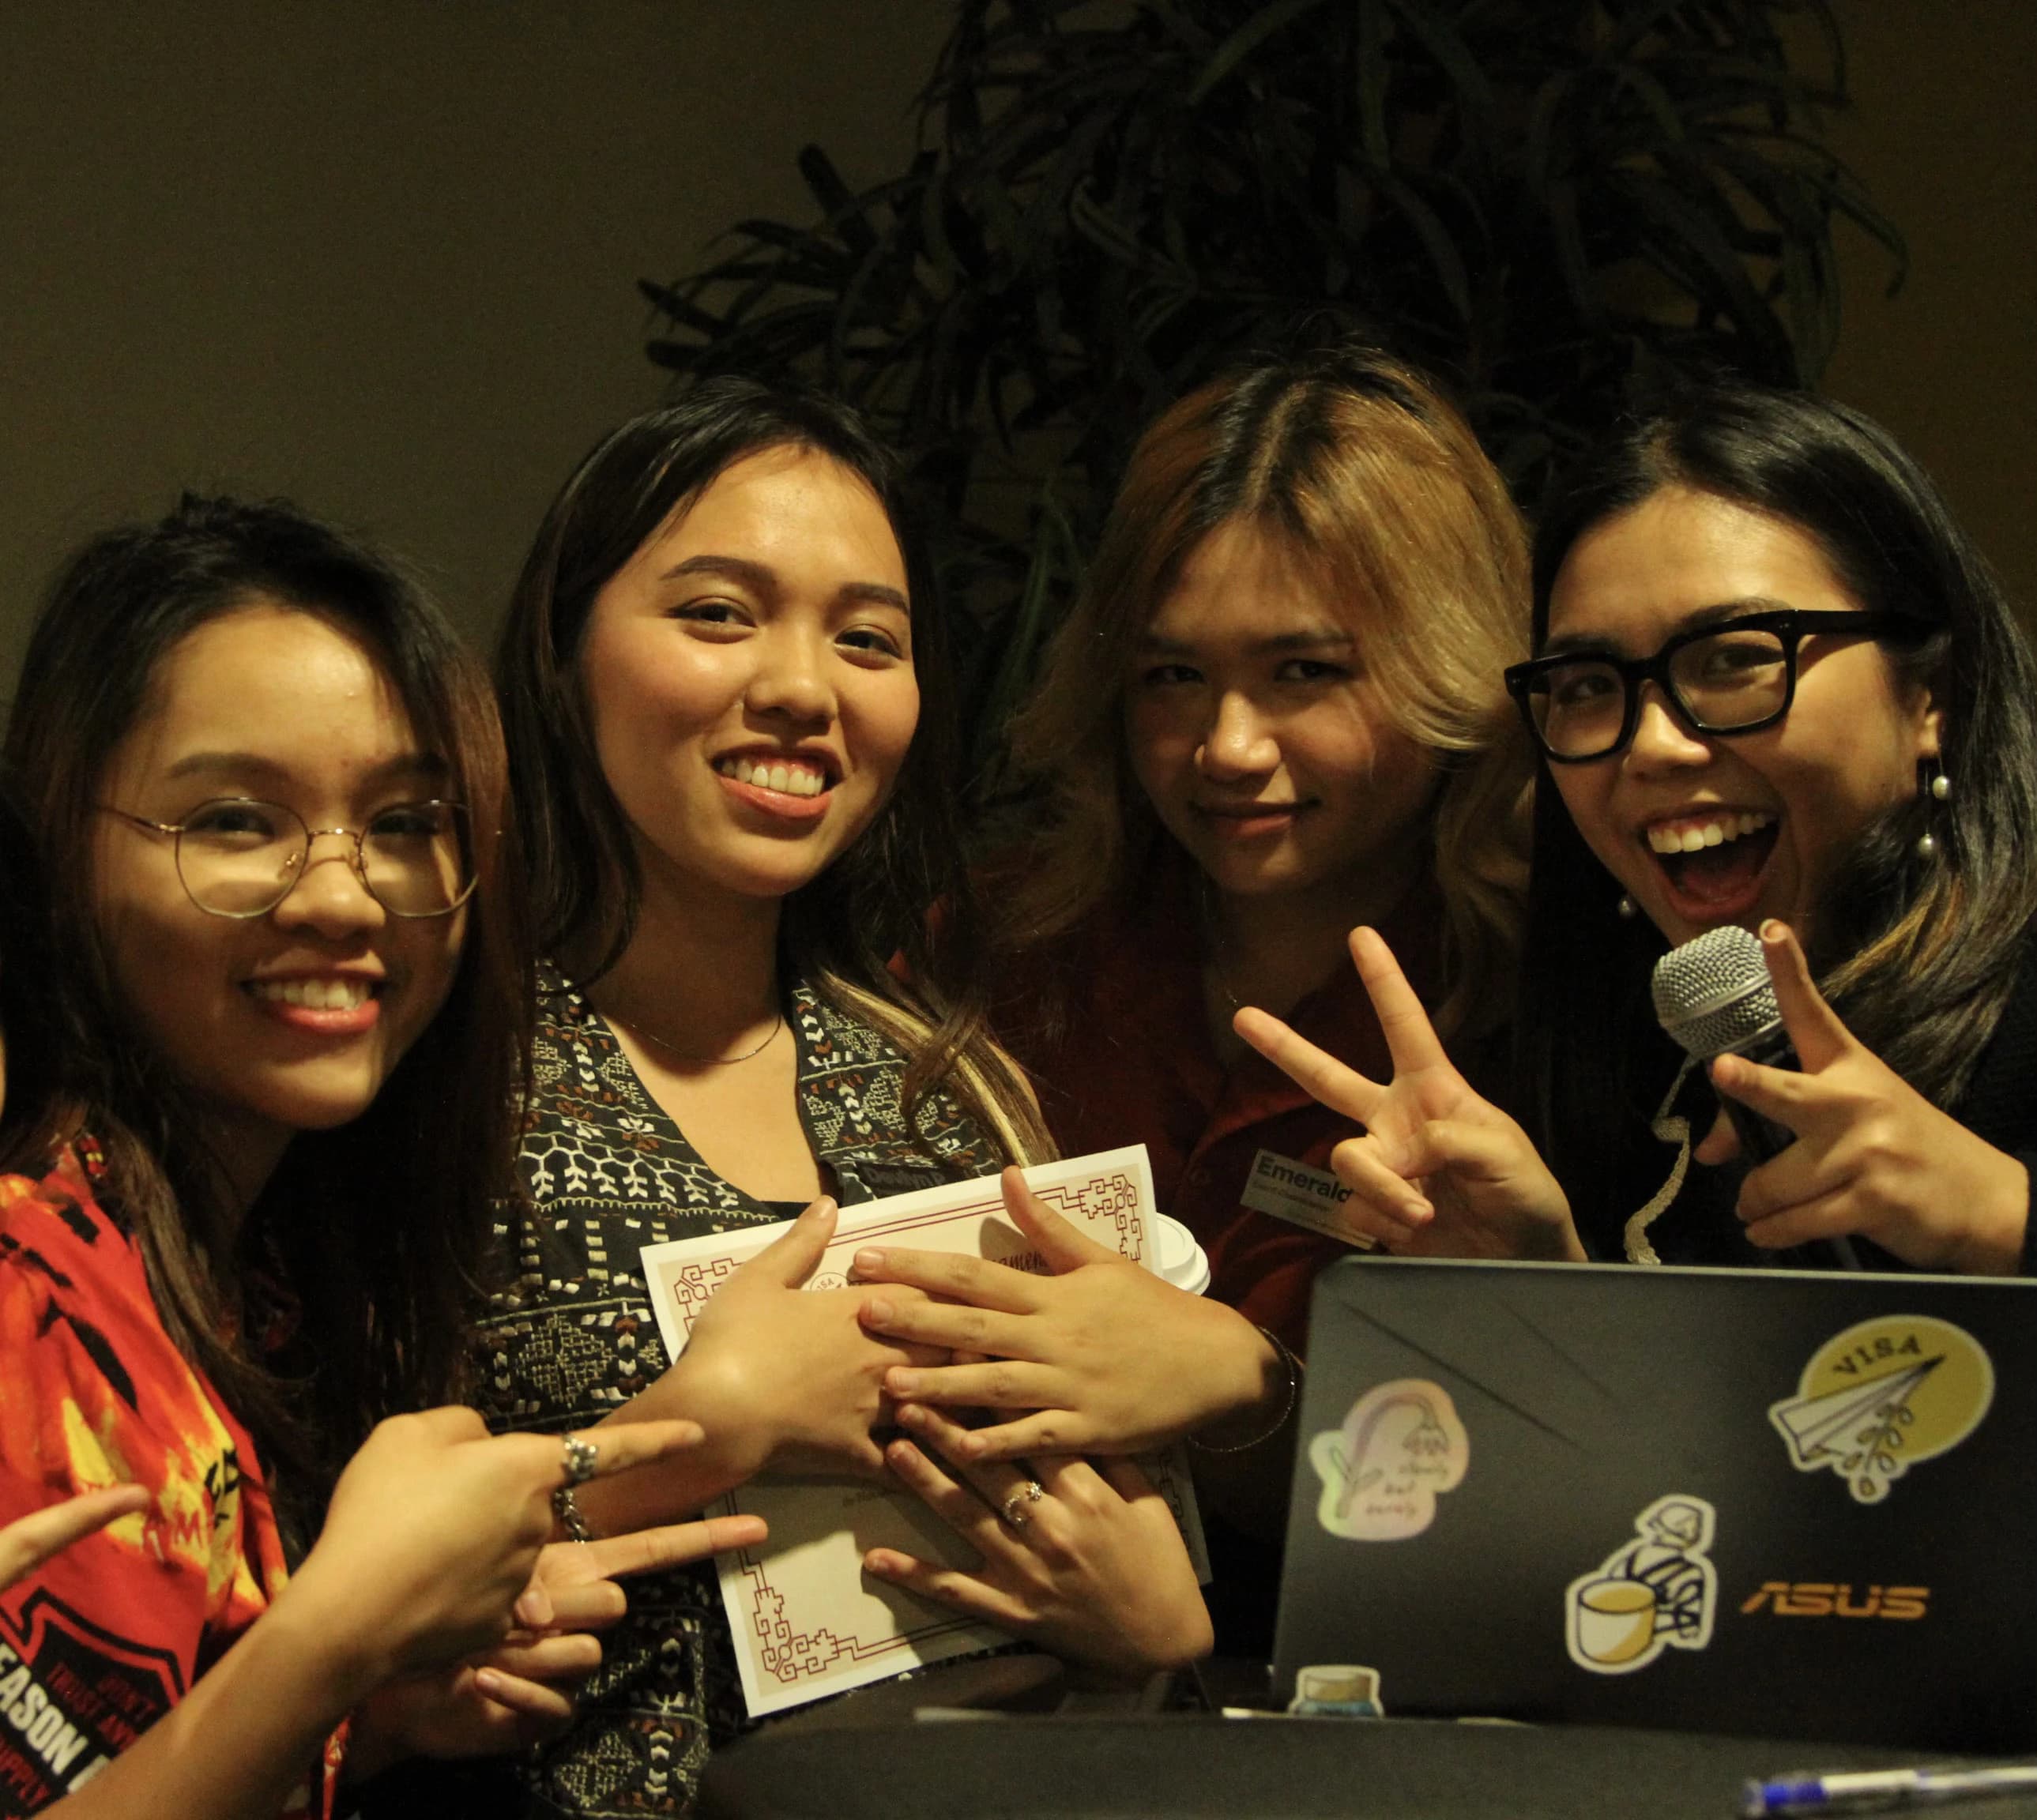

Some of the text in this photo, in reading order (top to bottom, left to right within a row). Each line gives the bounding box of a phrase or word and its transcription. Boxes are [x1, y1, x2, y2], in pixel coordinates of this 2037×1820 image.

[1256, 1156, 1353, 1203] Emerald
[1832, 1334, 1922, 1374] VISA
[1741, 1581, 1930, 1619] ASUS
